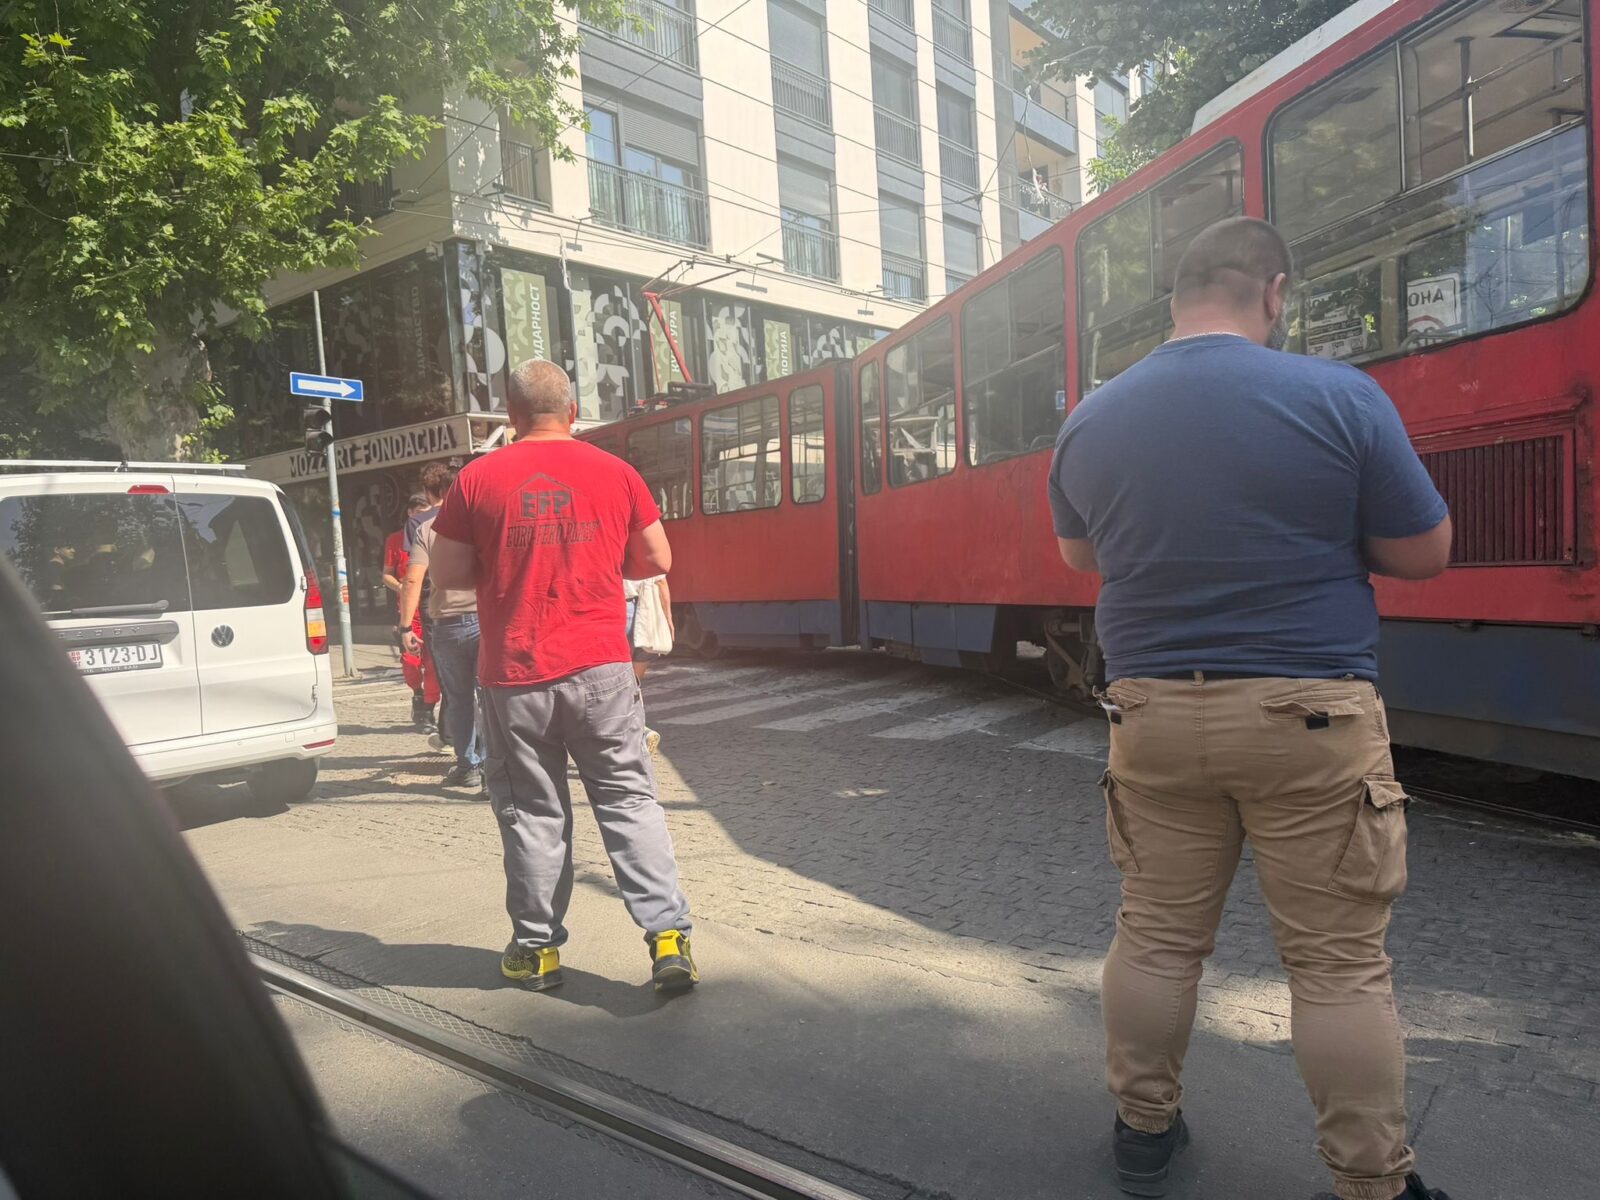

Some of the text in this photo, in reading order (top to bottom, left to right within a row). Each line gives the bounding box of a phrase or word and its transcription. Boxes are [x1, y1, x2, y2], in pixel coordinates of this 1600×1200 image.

[1408, 288, 1444, 307] ОНА
[529, 283, 544, 360] ИДАРНОСТ
[780, 331, 788, 375] ЛОГИЈА
[289, 424, 454, 479] MOZZRT FONDACIJA
[522, 490, 571, 518] EFP
[85, 644, 158, 665] 3123-DJ
